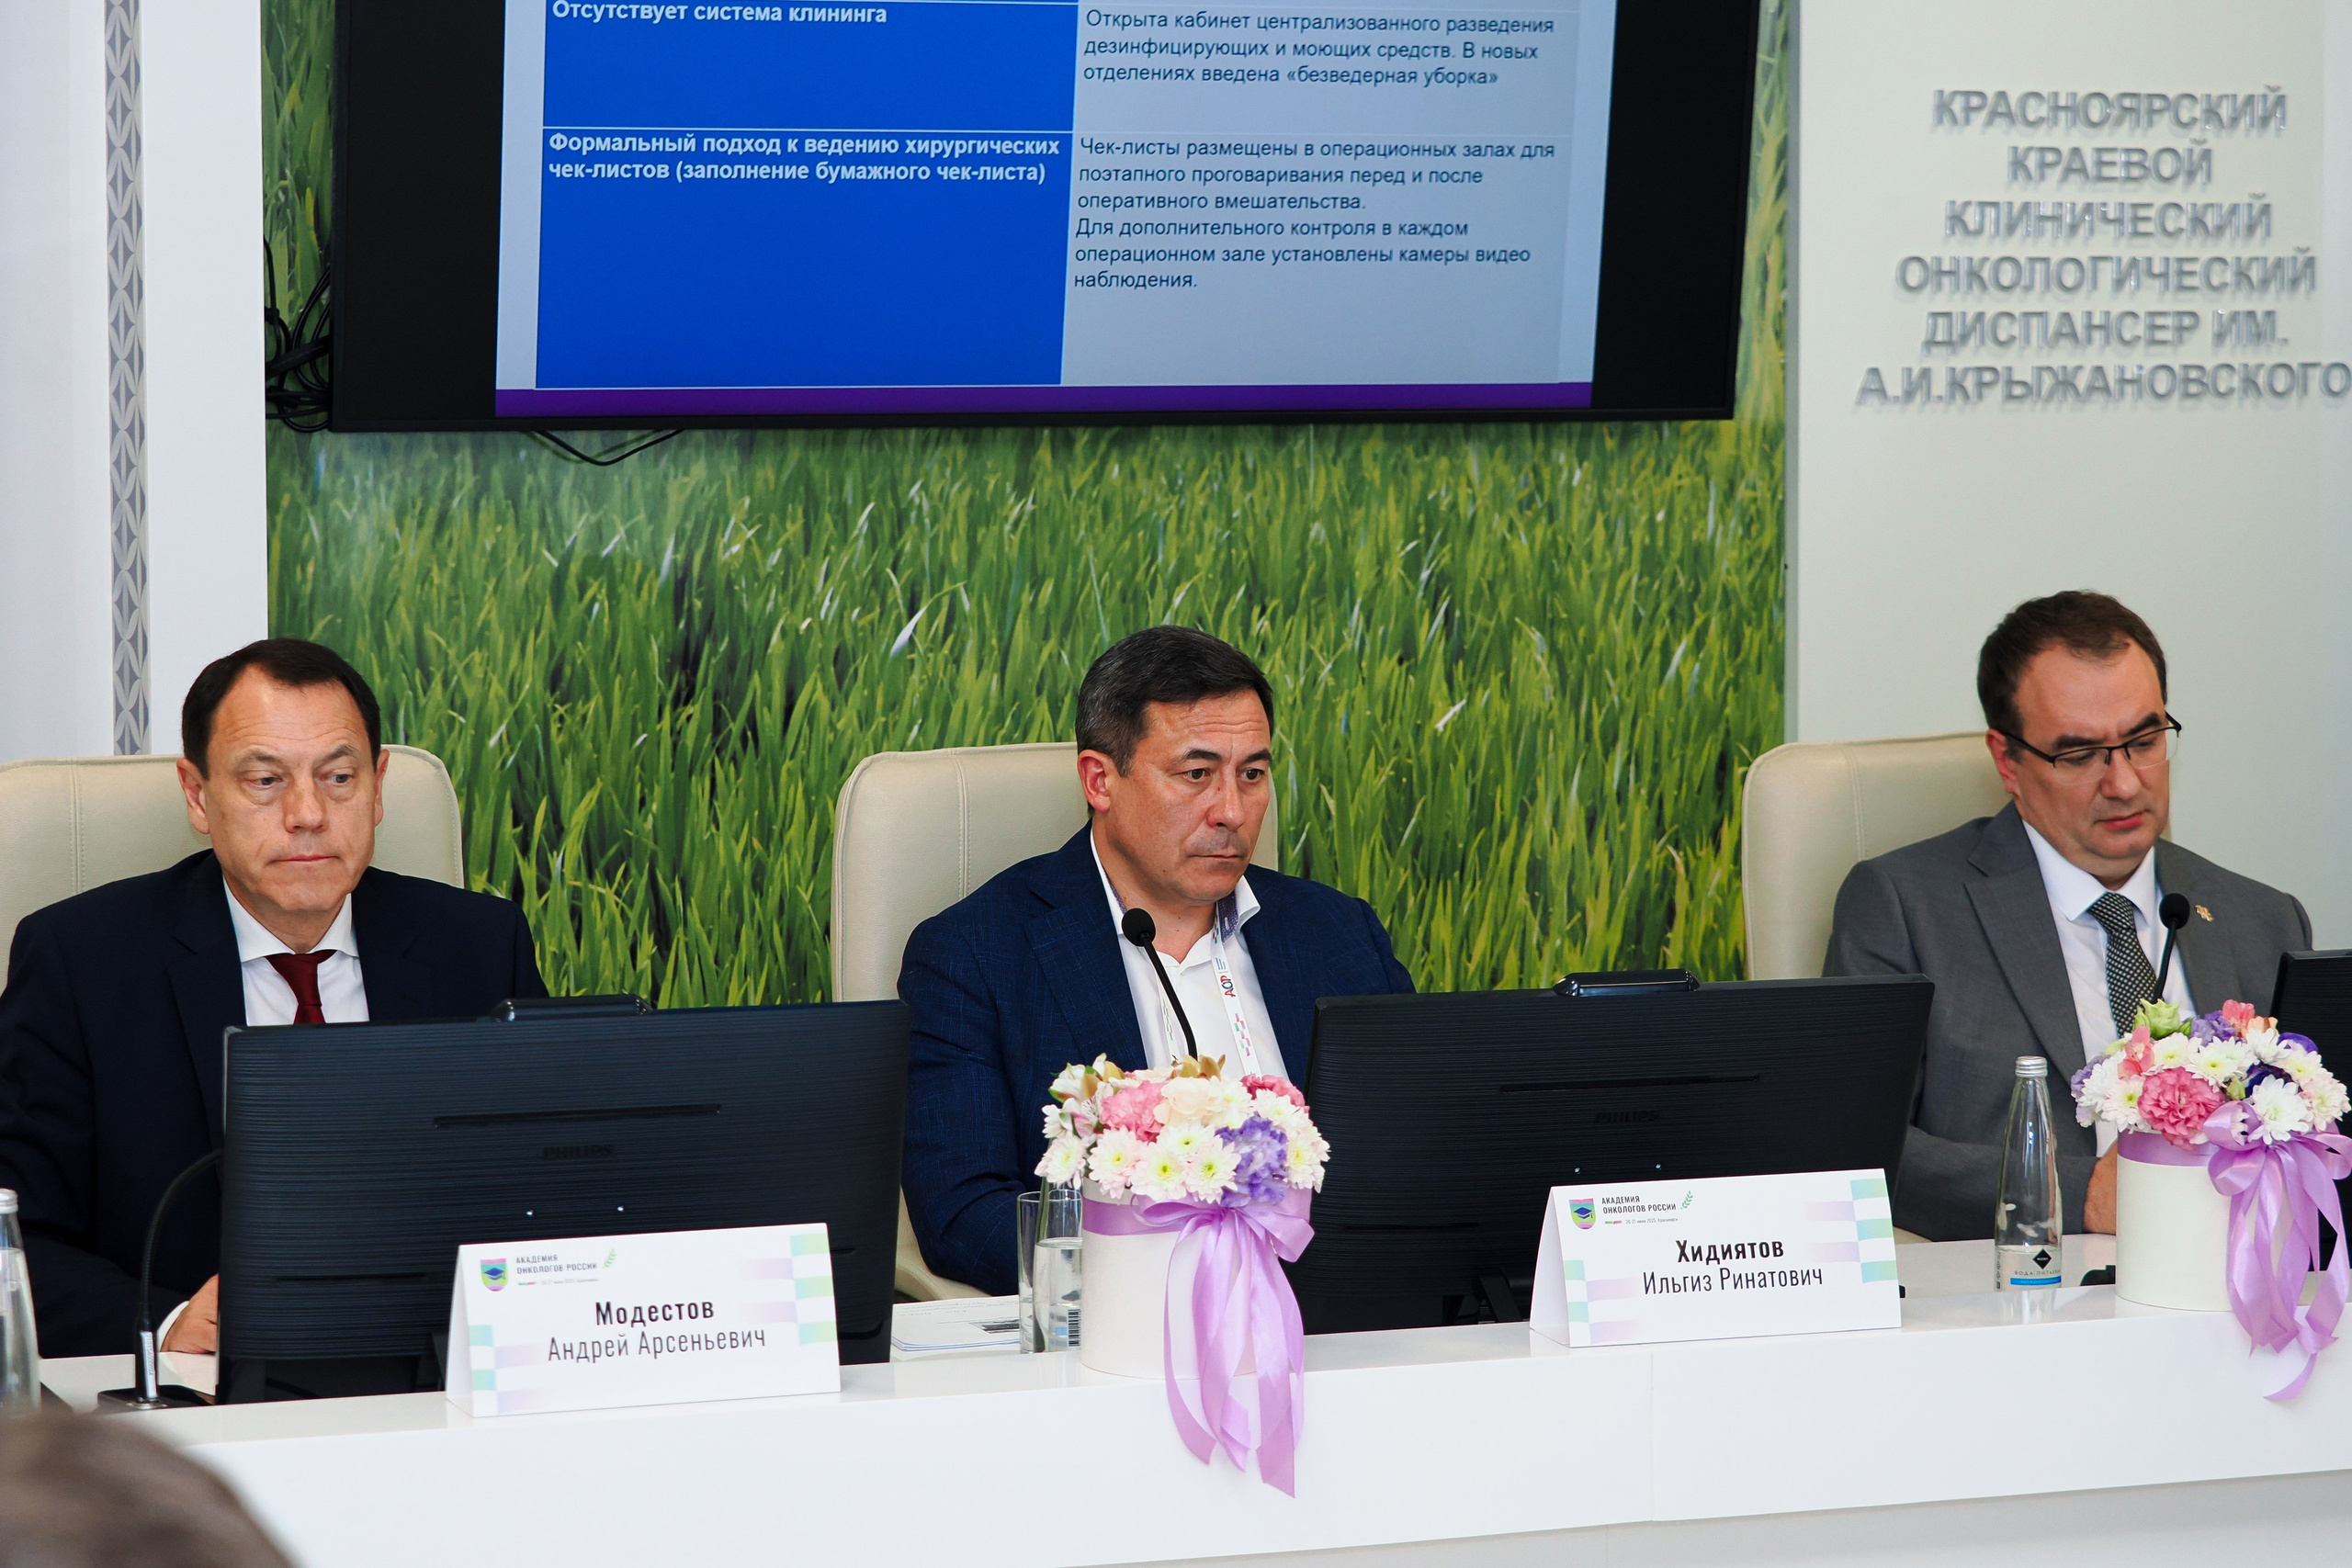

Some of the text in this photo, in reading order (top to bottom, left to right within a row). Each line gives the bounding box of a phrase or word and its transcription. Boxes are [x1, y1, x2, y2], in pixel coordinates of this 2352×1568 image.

[553, 0, 887, 23] Отсутствует система клининга
[1087, 9, 1553, 35] Открыта кабинет централизованного разведения
[1084, 38, 1538, 60] дезинфицирующих и моющих средств. В новых
[1084, 65, 1498, 87] отделениях введена «безведерная уборка»
[1932, 85, 2288, 132] КРАСНОЯРСКИЙ
[549, 133, 1059, 158] Формальный подход к ведению хирургических
[1081, 138, 1555, 160] Чек-листы размещены в операционных залах для
[549, 161, 1045, 185] чек-листов (заполнение бумажного чек-листа)
[2007, 140, 2212, 184] КРАЕВОЙ
[1080, 169, 1482, 186] поэтапного проговаривания перед и после
[1079, 196, 1364, 212] оперативного вмешательства.
[1944, 193, 2272, 237] КЛИНИЧЕСКИЙ
[1076, 219, 1467, 239] Для дополнительного контроля в каждом
[1076, 250, 1530, 265] операционном зале установлены камеры видео
[1075, 270, 1196, 289] наблюдения.
[1895, 247, 2317, 292] ОНКОЛОГИЧЕСКИЙ
[1922, 309, 2289, 353] ДИСПАНСЕР ИМ.
[1857, 362, 2352, 404] А.И.КРЫЖАНОВСКОГО
[1602, 1196, 1640, 1204] АКАДЕМИЯ
[1603, 1205, 1645, 1213] ОНКОЛОГОВ
[516, 1255, 557, 1263] АКАДЕМИЯ
[1676, 1240, 1783, 1265] Хидиятов
[517, 1265, 563, 1274] ОНКОЛОГОВ
[1644, 1268, 1822, 1294] Ильгиз Ринатович
[596, 1302, 713, 1327] Модестов
[548, 1330, 764, 1363] Андрей Арсеньевич
